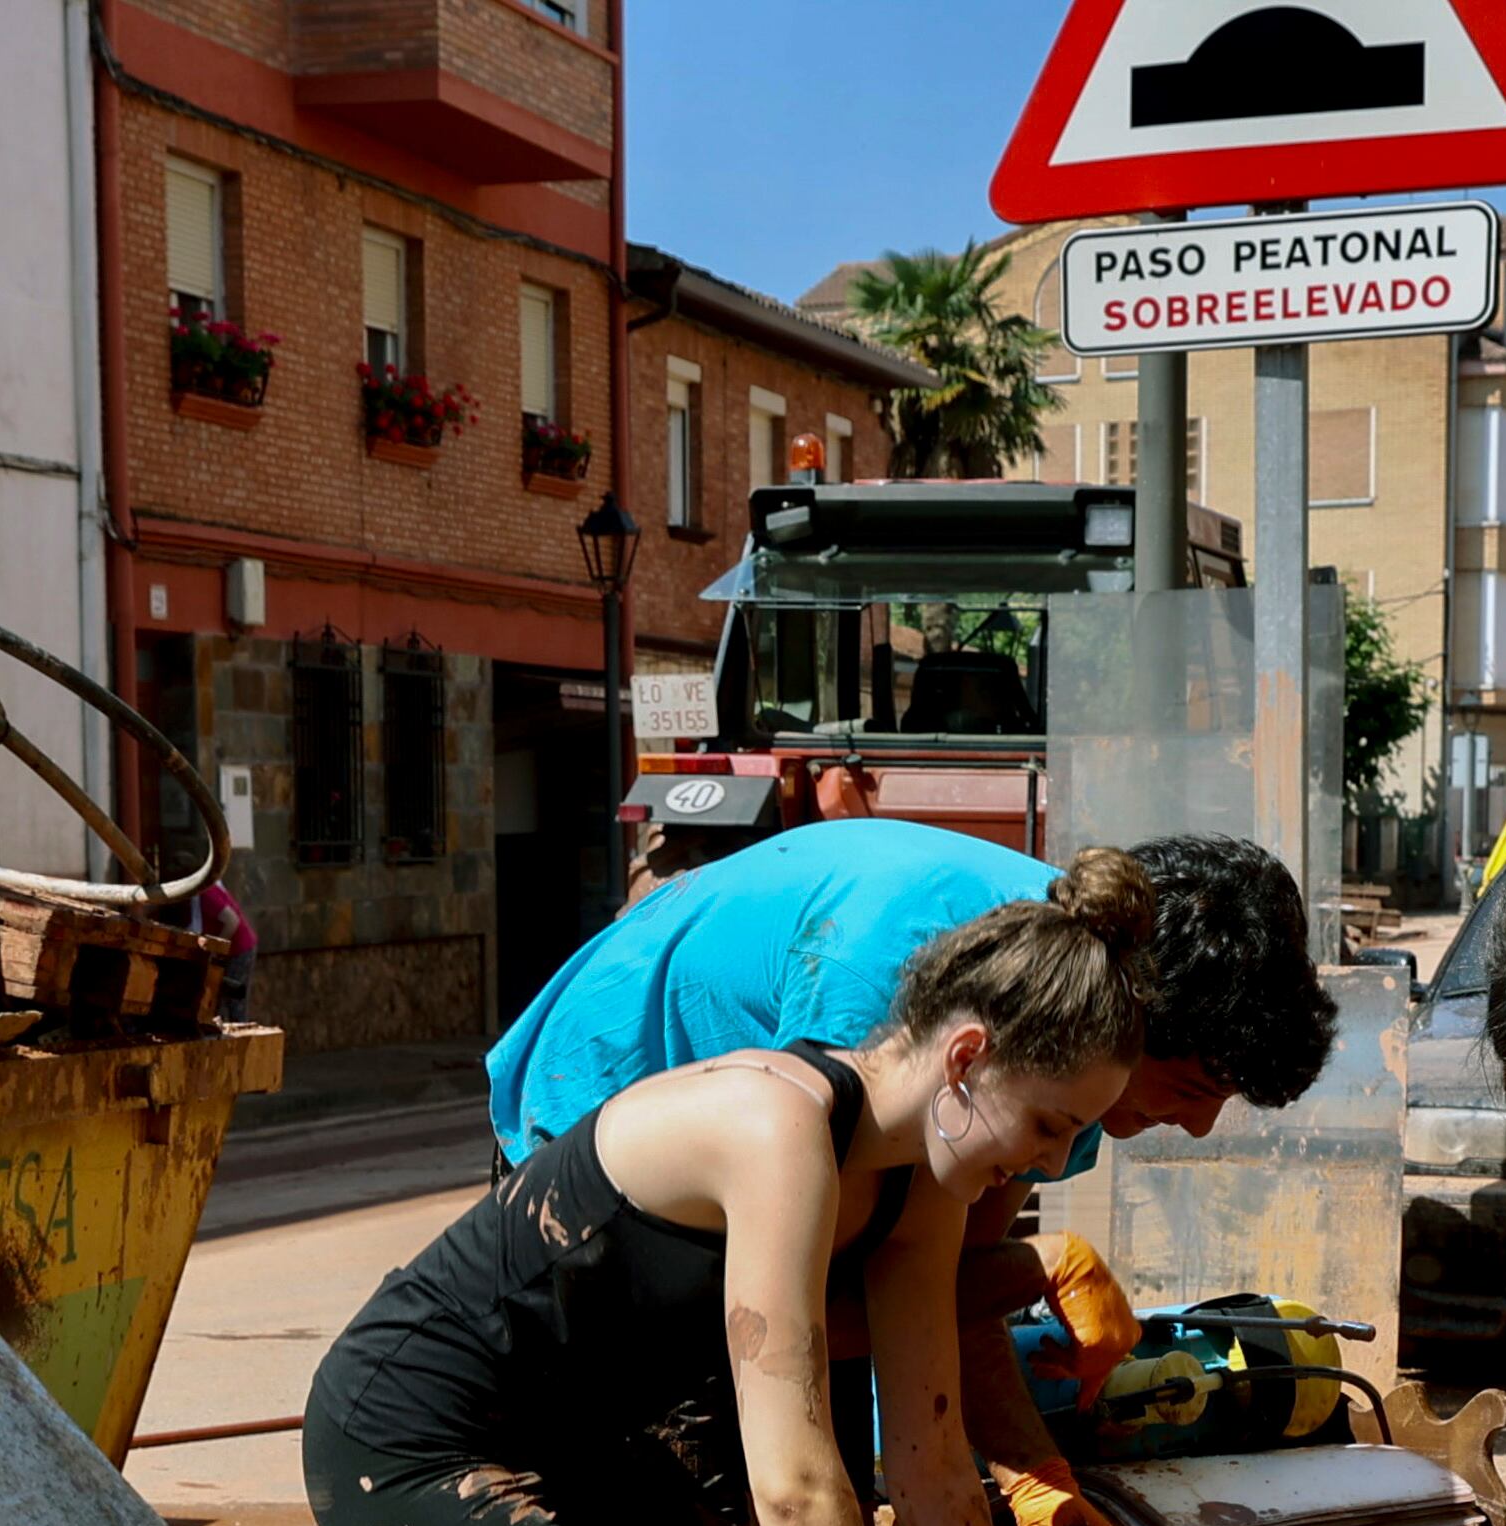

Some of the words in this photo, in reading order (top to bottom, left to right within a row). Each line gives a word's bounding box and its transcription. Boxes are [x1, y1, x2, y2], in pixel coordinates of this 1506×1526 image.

[1095, 244, 1206, 283] PASO
[1233, 226, 1457, 273] PEATONAL
[1103, 275, 1452, 332] SOBREELEVADO
[649, 709, 709, 731] 35155
[674, 783, 717, 809] 40
